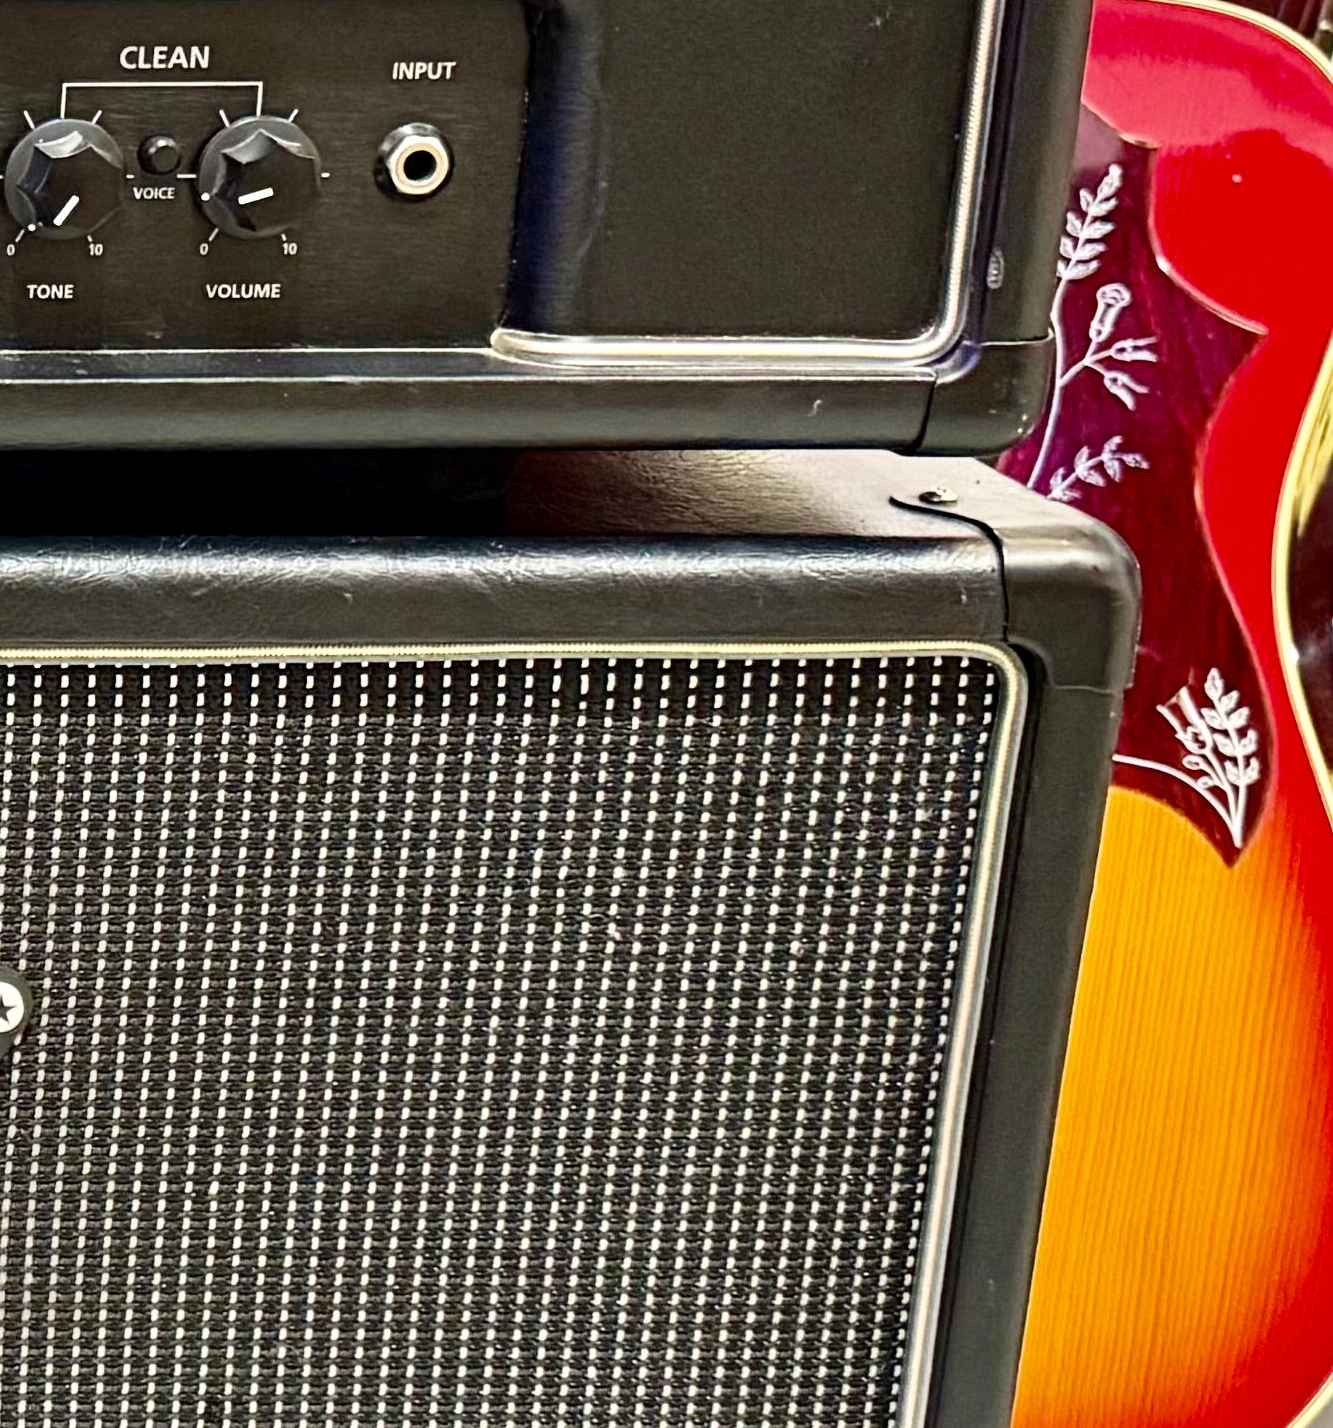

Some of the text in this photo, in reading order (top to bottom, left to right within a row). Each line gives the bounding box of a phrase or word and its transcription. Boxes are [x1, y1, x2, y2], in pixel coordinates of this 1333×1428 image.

[119, 45, 210, 70] CLEAN
[392, 61, 457, 80] INPUT
[132, 186, 176, 200] VOICE
[6, 243, 104, 257] 0 10
[199, 242, 298, 256] 0 10
[26, 284, 74, 300] TONE
[205, 283, 281, 299] VOLUME
